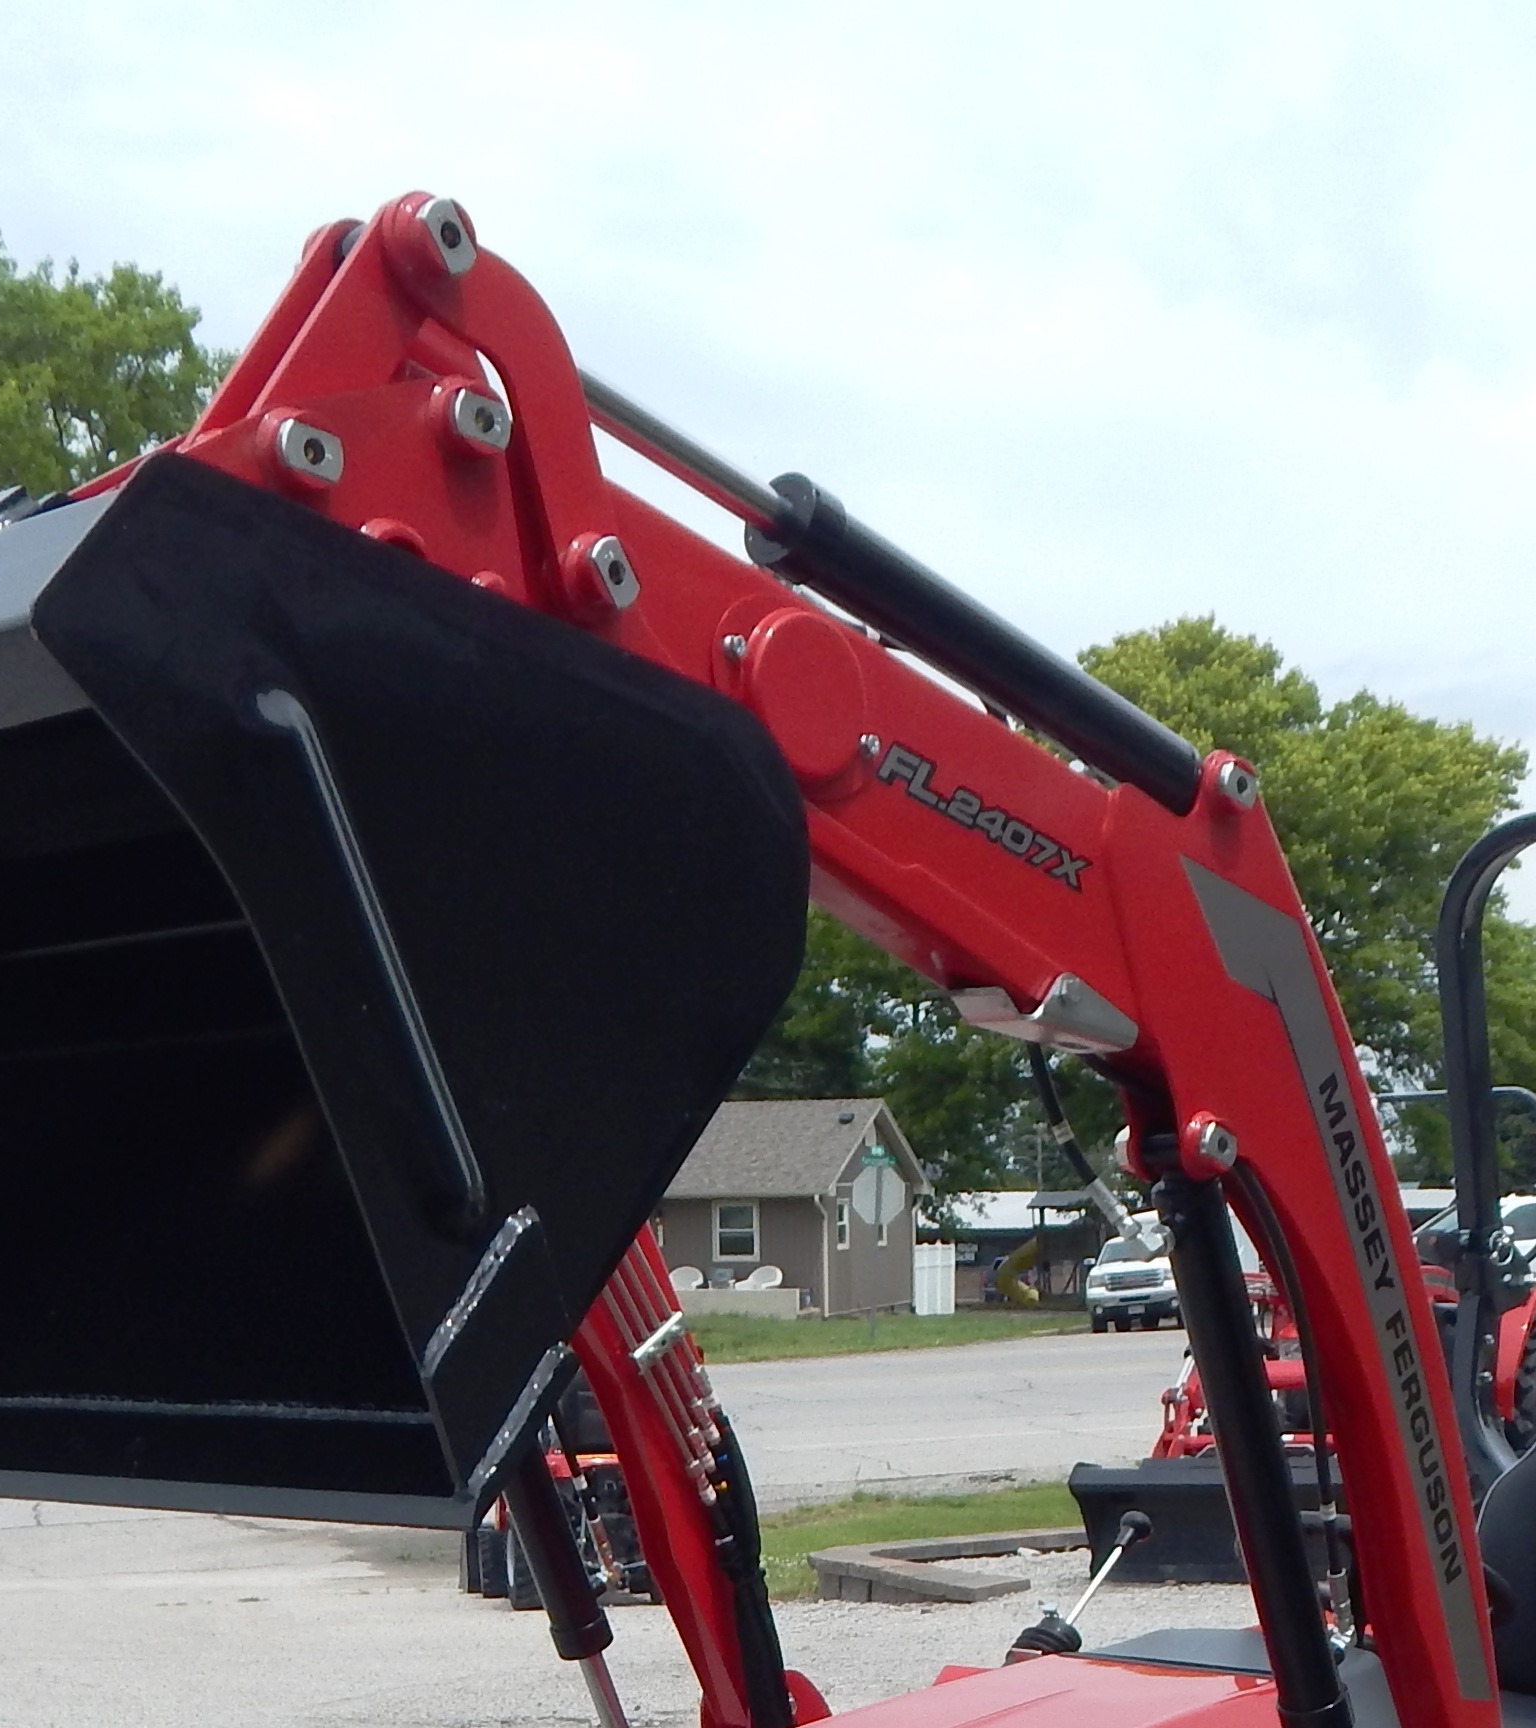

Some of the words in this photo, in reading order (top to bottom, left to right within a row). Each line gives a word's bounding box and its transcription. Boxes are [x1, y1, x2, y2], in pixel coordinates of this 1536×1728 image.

[877, 742, 1091, 891] FL.2407X
[1318, 1073, 1395, 1291] MASSEY
[1385, 1310, 1463, 1584] FERGUSON
